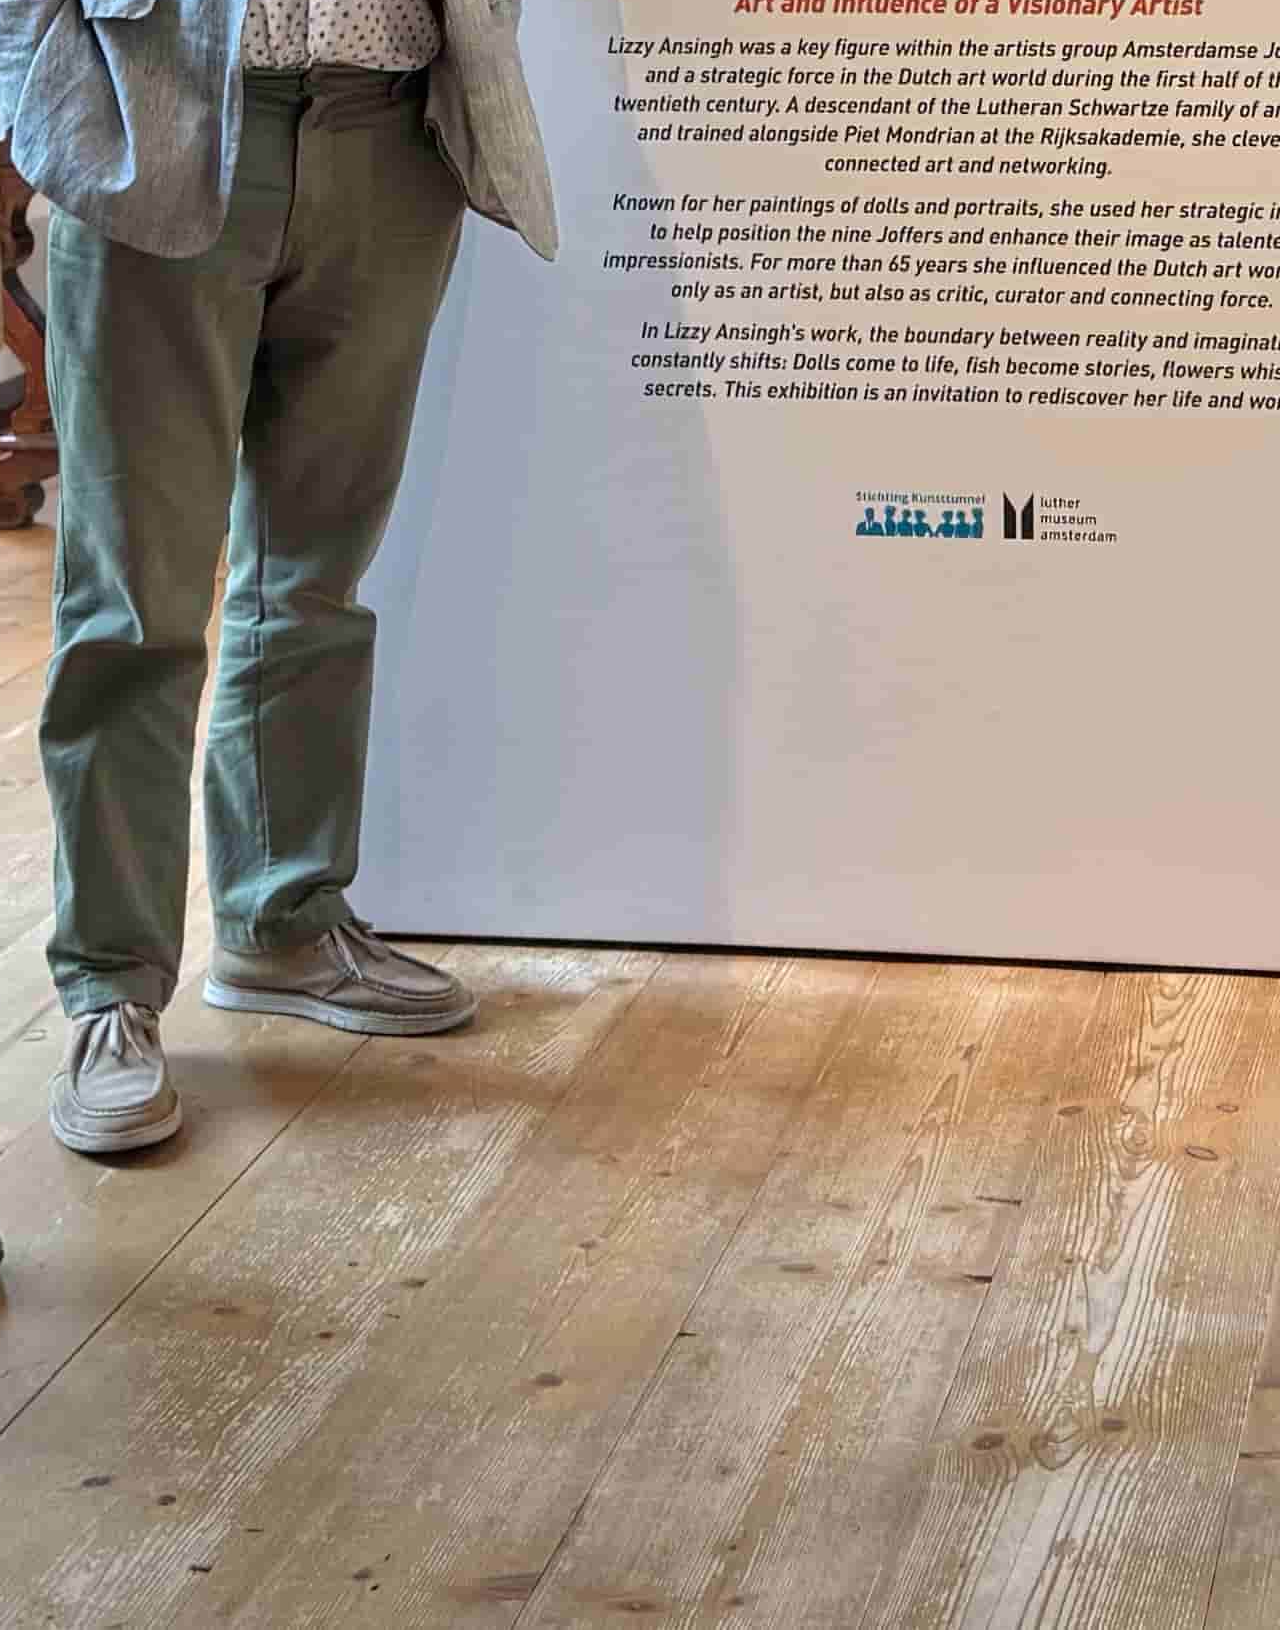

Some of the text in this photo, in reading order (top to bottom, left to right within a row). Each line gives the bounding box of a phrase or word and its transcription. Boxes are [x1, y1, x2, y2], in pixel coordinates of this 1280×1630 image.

[608, 36, 655, 58] Lizzy
[658, 37, 733, 59] Ansingh
[740, 42, 776, 55] was
[780, 42, 792, 55] a
[797, 37, 830, 60] key
[834, 38, 890, 60] figure
[896, 38, 952, 58] within
[959, 38, 989, 57] the
[994, 39, 1056, 58] artists
[1061, 44, 1118, 62] group
[1122, 40, 1258, 58] Amsterdamse
[825, 154, 1112, 179] connected art and networking.
[642, 322, 658, 338] In
[664, 322, 712, 344] Lizzy
[714, 322, 805, 345] Ansingh's
[811, 324, 862, 346] work,
[869, 324, 899, 343] the
[904, 325, 995, 349] boundary
[1000, 327, 1080, 346] between
[1086, 330, 1148, 352] reality
[1152, 331, 1189, 349] and
[632, 351, 726, 373] constantly
[729, 351, 788, 370] shifts:
[793, 352, 840, 371] Dolls
[846, 358, 896, 372] come
[902, 355, 919, 372] to
[925, 355, 958, 377] life,
[966, 356, 1000, 374] fish
[1005, 356, 1079, 377] become
[1084, 358, 1155, 381] stories,
[1162, 360, 1235, 379] flowers
[643, 380, 716, 398] secrets.
[724, 380, 762, 399] This
[768, 381, 858, 400] exhibition
[864, 382, 879, 400] is
[884, 388, 907, 402] an
[912, 383, 999, 402] invitation
[1006, 387, 1023, 404] to
[1028, 387, 1129, 406] rediscover
[1134, 388, 1168, 407] her
[1172, 389, 1202, 408] life
[1208, 391, 1244, 409] and
[856, 491, 909, 505] Stichting
[1039, 496, 1081, 510] luther
[1039, 514, 1097, 527] museum
[1039, 529, 1118, 543] amsterdam
